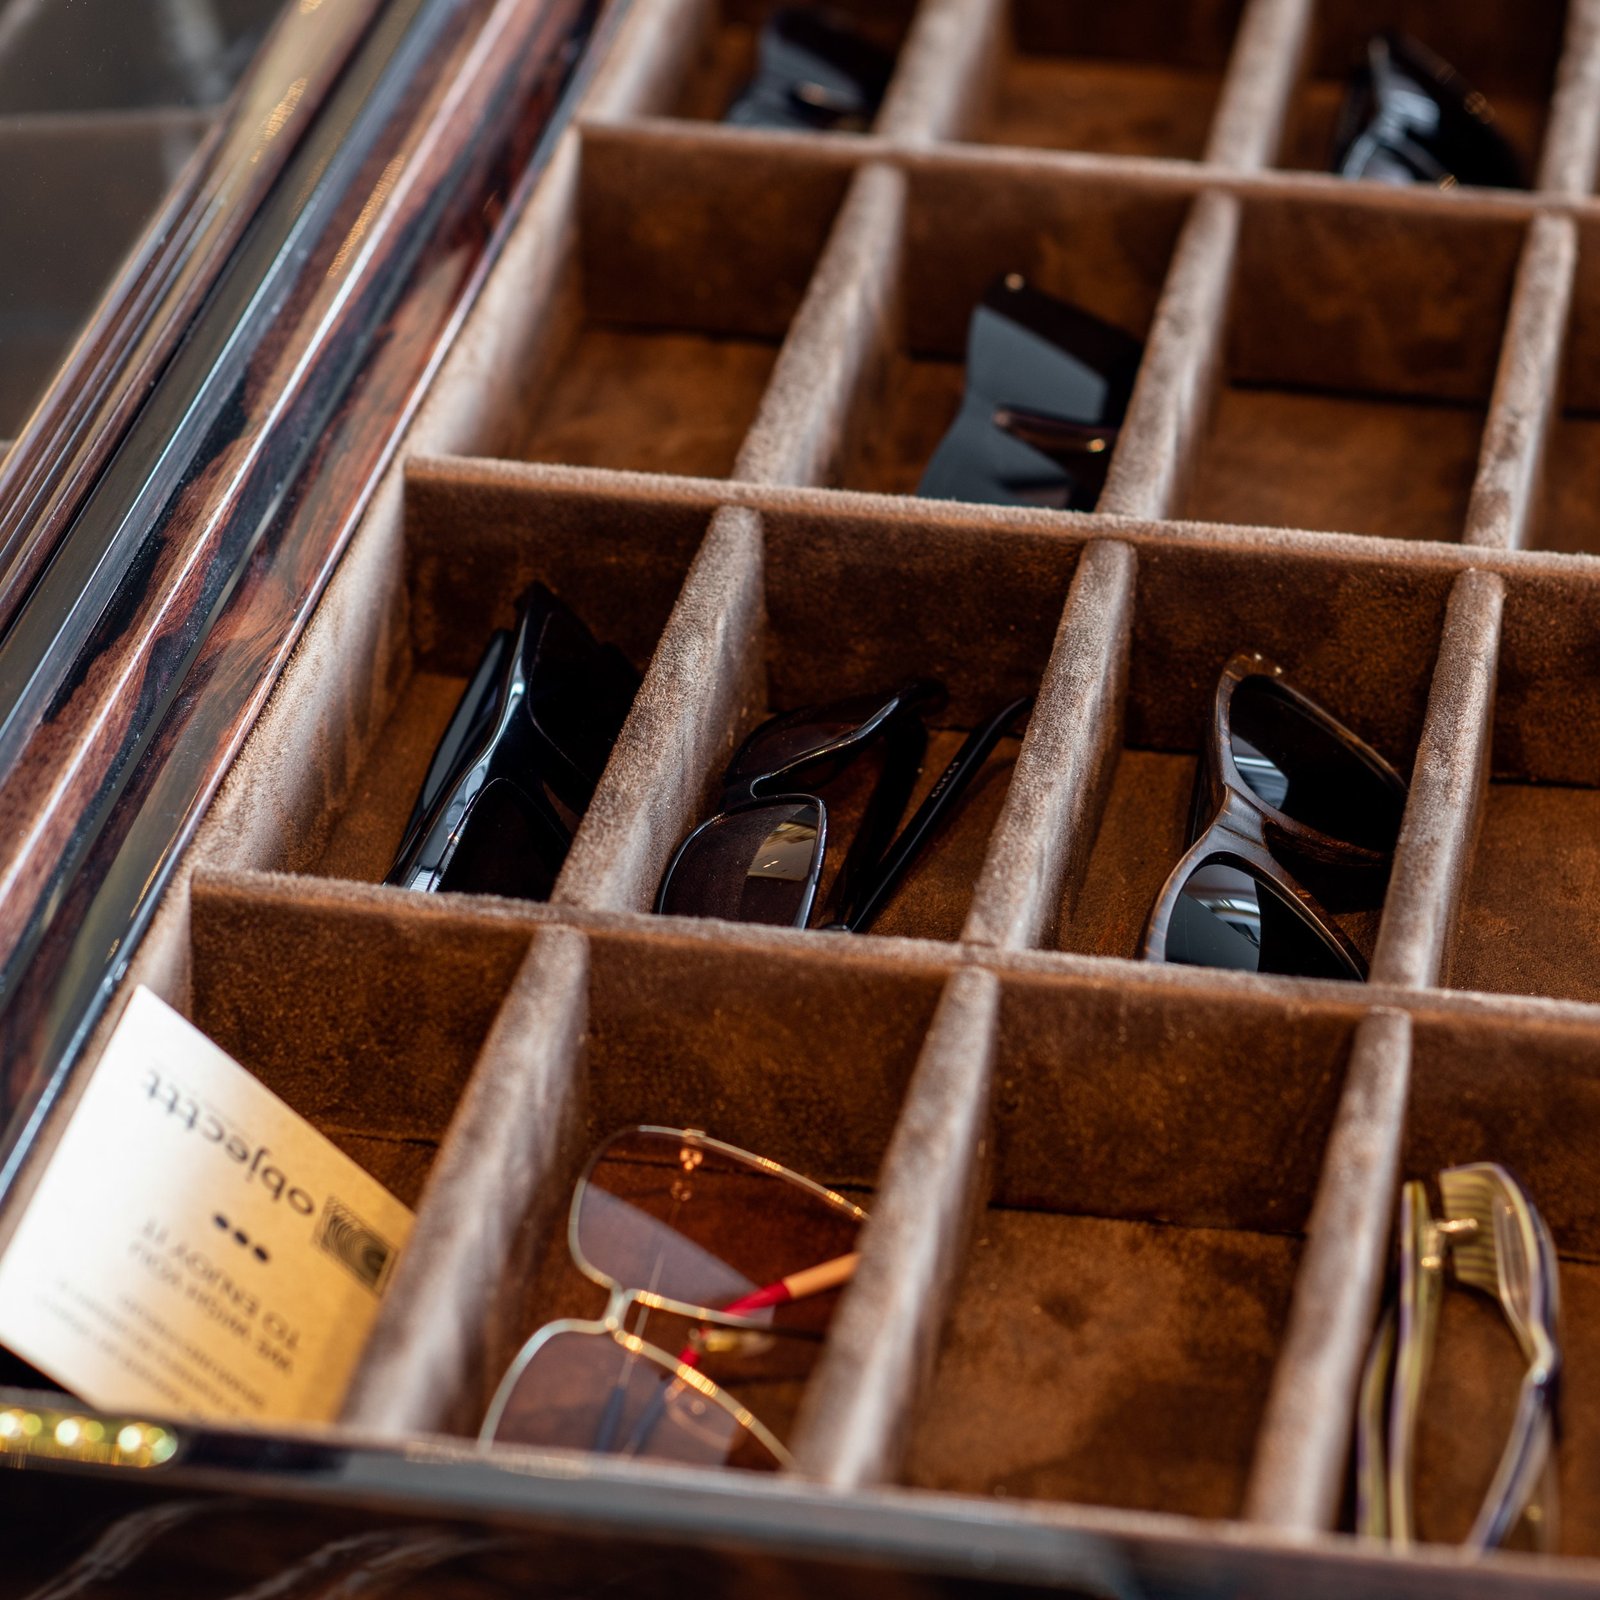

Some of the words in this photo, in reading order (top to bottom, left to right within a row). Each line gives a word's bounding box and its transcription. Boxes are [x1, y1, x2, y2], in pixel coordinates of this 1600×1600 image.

[142, 1068, 316, 1217] objecttt
[169, 1240, 260, 1319] ENJOY
[262, 1311, 300, 1350] TO
